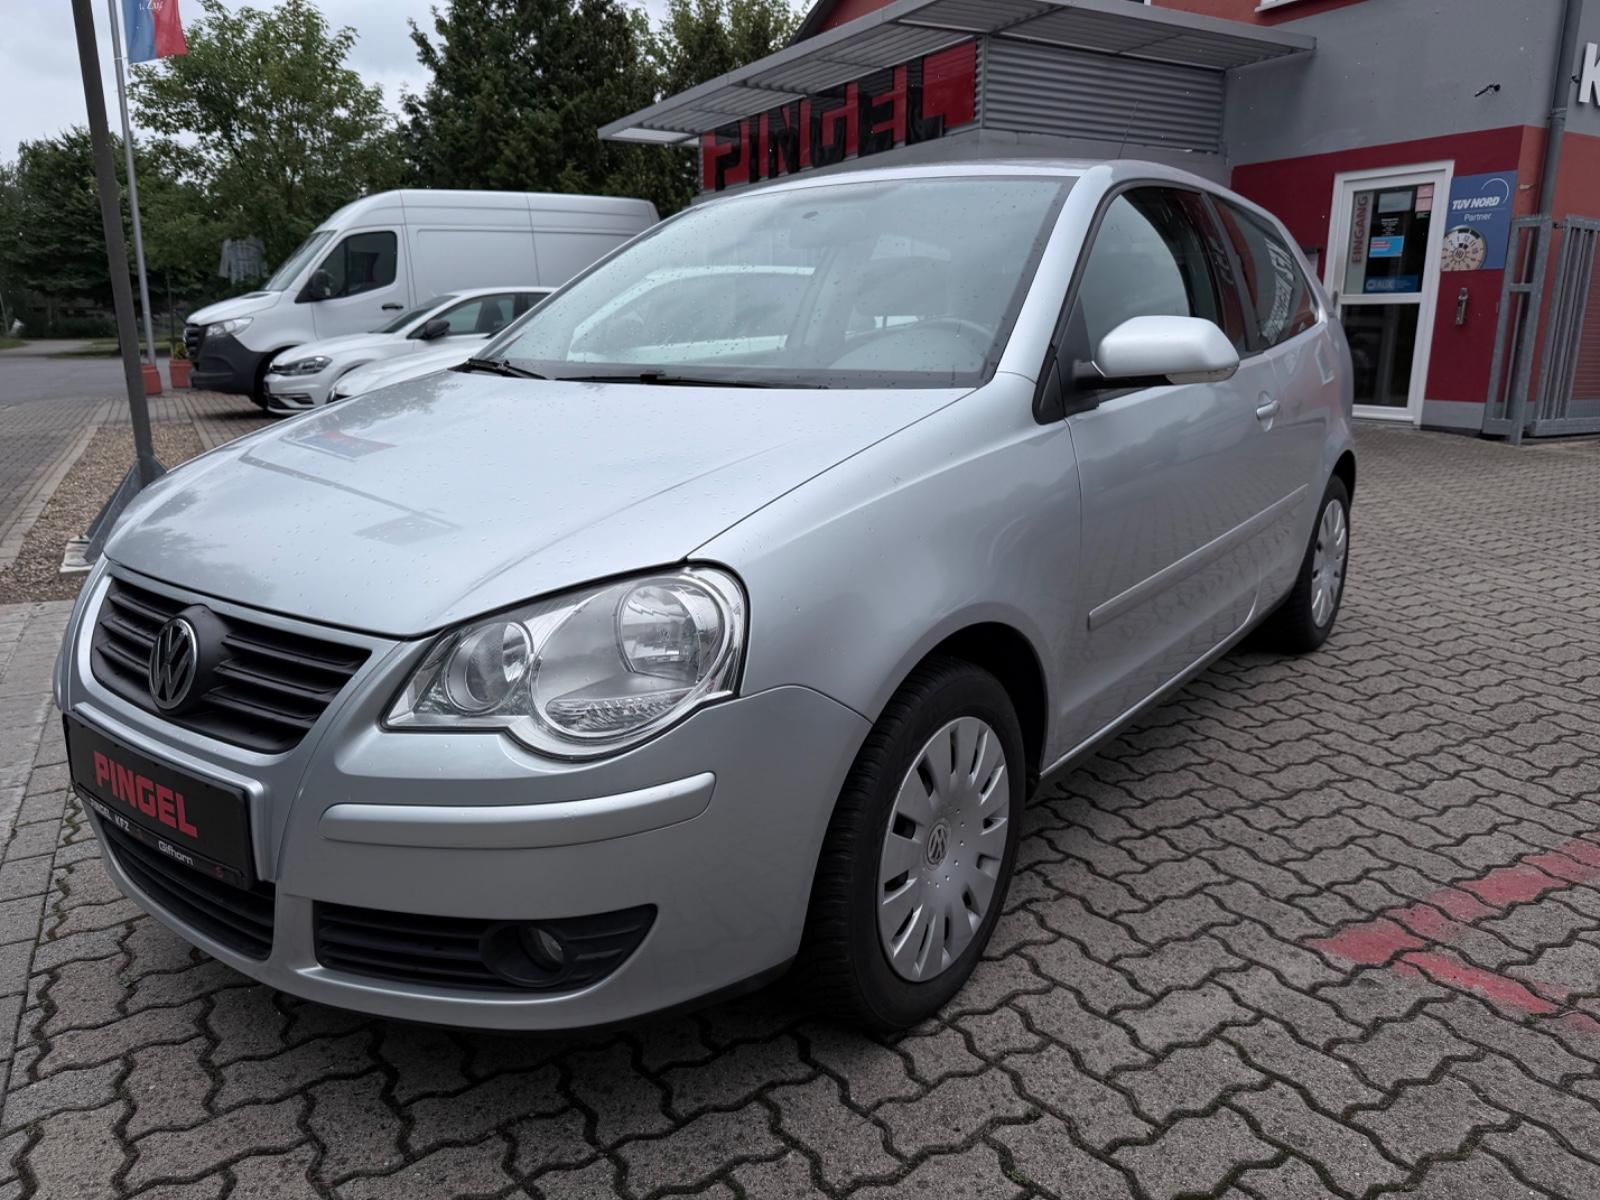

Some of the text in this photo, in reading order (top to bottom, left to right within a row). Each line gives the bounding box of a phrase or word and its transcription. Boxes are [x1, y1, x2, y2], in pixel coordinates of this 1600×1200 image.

[714, 55, 945, 191] PINGEL
[1351, 195, 1369, 264] EINGANG
[1464, 212, 1492, 222] Partner
[1470, 196, 1500, 208] NORD
[92, 750, 199, 839] PINGEL
